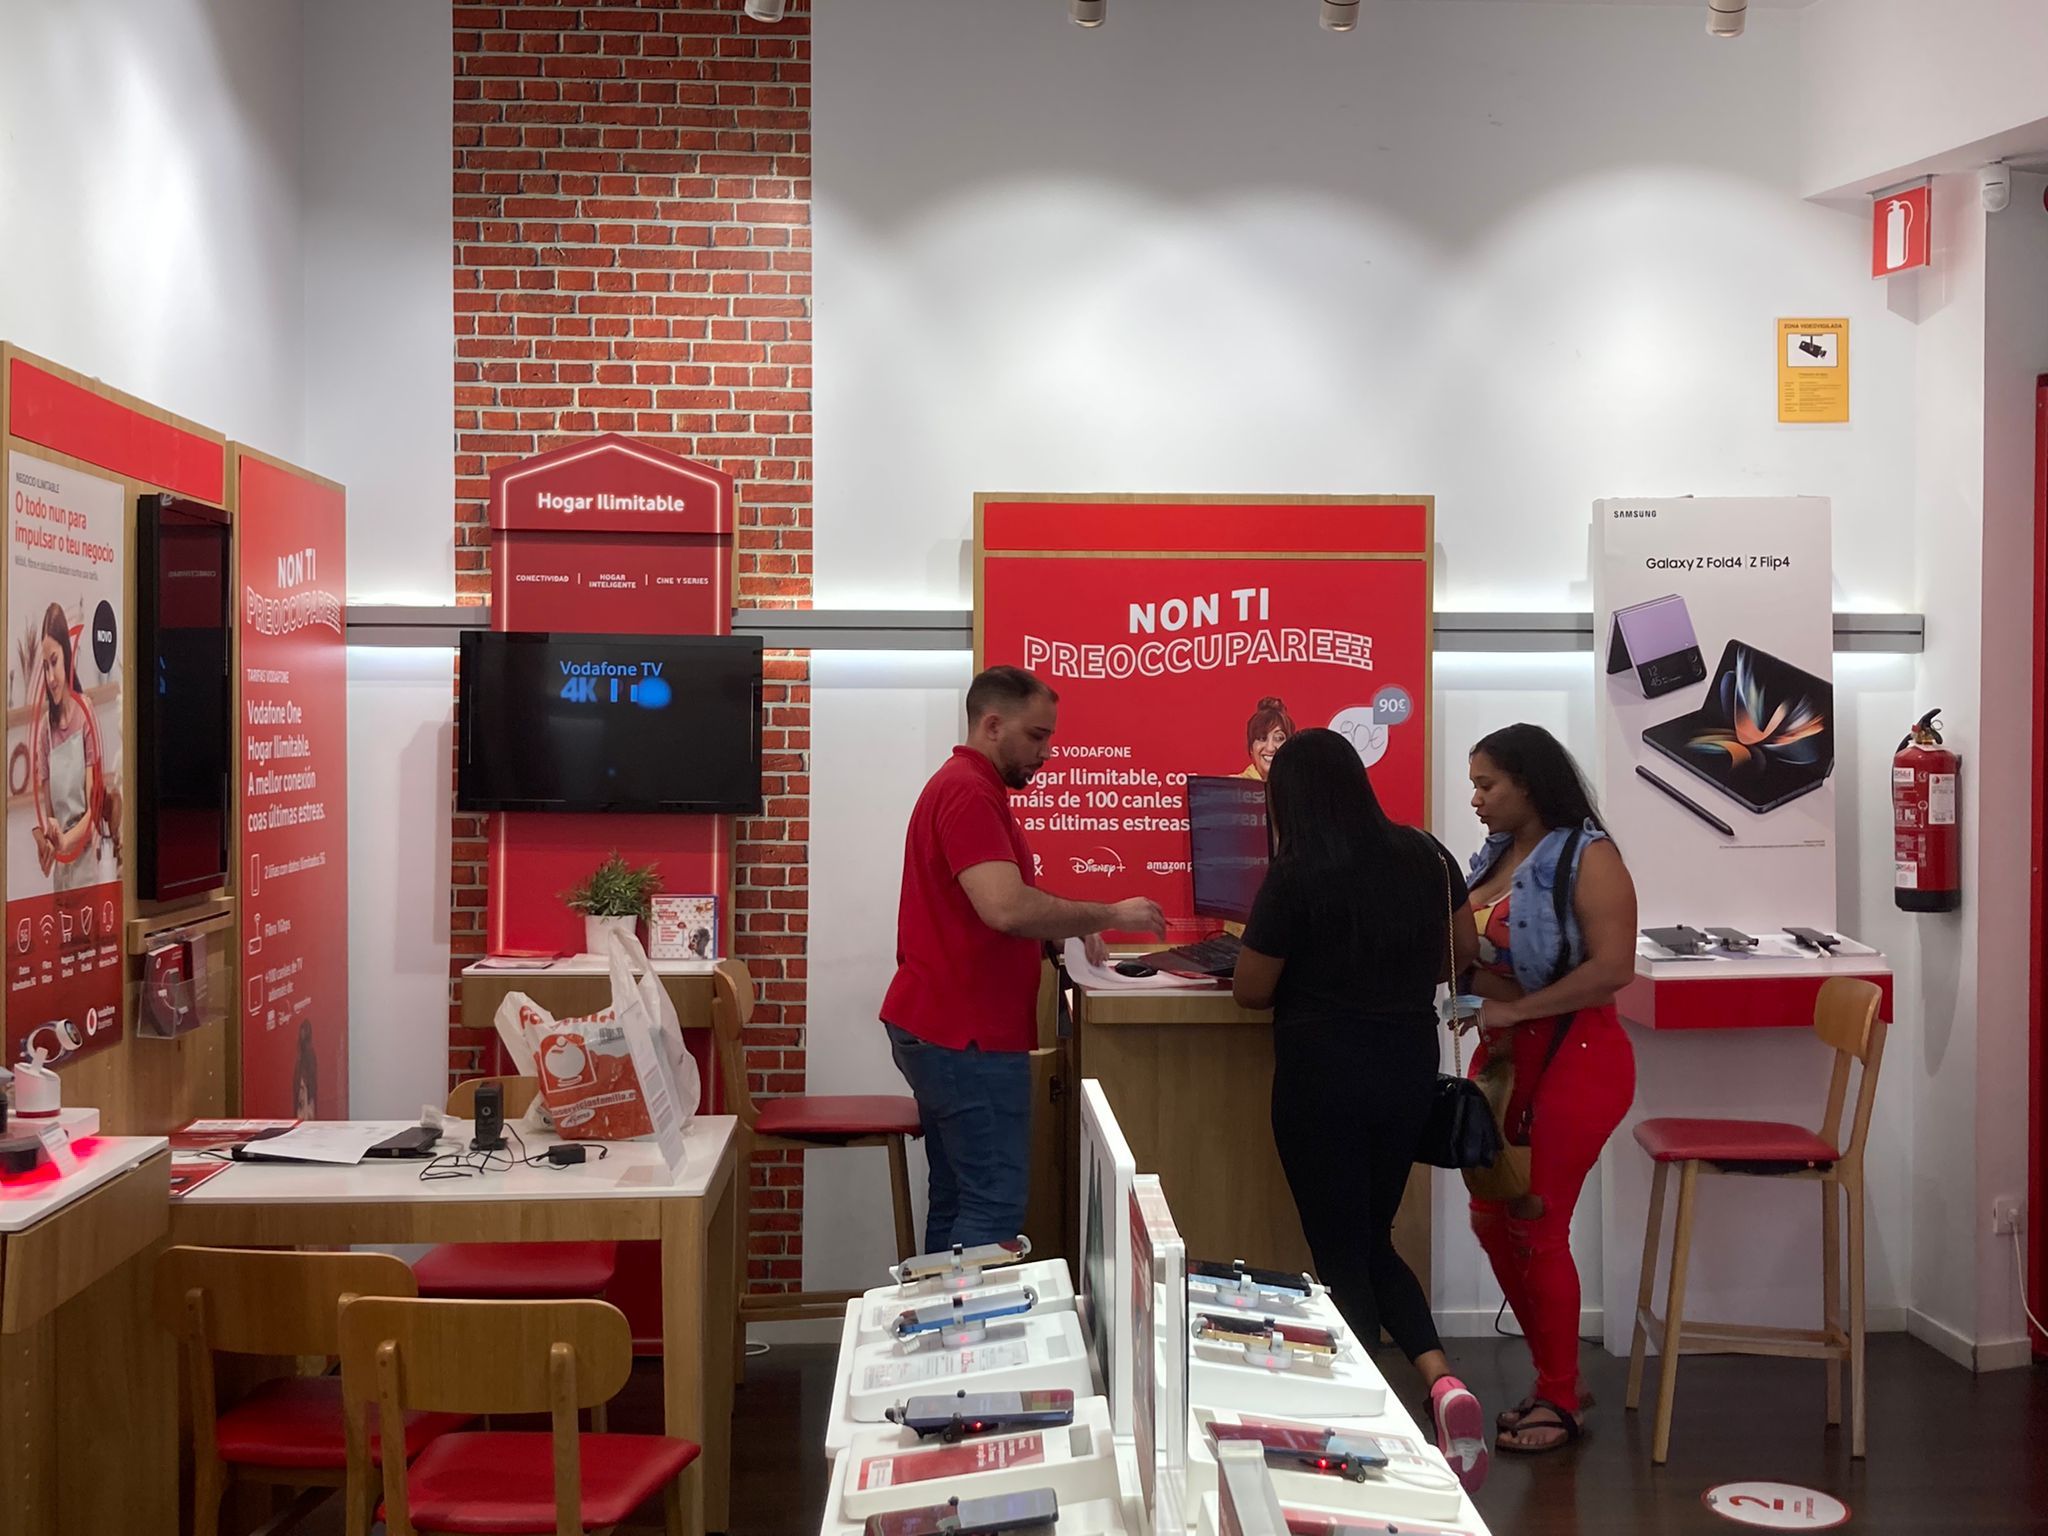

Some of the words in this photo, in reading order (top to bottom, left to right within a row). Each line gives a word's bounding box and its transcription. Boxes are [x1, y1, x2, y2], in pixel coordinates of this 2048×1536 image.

[16, 491, 24, 513] O
[25, 496, 47, 519] todo
[49, 504, 67, 524] nun
[68, 510, 87, 531] para
[537, 492, 594, 513] Hogar
[597, 494, 685, 513] Ilimitable
[1613, 510, 1657, 518] SAMSUNG
[15, 521, 56, 550] impulsar
[58, 536, 65, 551] o
[66, 537, 81, 556] teu
[81, 543, 114, 565] negocio
[278, 550, 304, 589] NON
[305, 548, 316, 581] TI
[1646, 557, 1694, 571] Galaxy
[1696, 557, 1704, 569] Z
[1706, 556, 1742, 569] Fold4
[1750, 557, 1757, 568] Z
[1760, 555, 1791, 571] Flip4
[515, 574, 569, 583] CONECTIVIDAD
[589, 581, 636, 589] INTELIGENTE
[600, 573, 626, 581] HOGAR
[656, 577, 674, 585] CINE
[676, 577, 682, 585] Y
[683, 577, 709, 585] SERIES
[1129, 593, 1219, 634] NON
[1231, 587, 1269, 622] TI
[560, 660, 638, 676] Vodafone
[641, 662, 663, 676] TV
[560, 676, 598, 703] 4K
[247, 700, 285, 725] Vodafone
[286, 700, 302, 724] One
[1379, 698, 1406, 713] 90€
[247, 735, 273, 766] Hogar
[274, 734, 311, 760] Ilimitable.
[1062, 746, 1132, 758] VODAFONE
[248, 771, 255, 797] A
[256, 770, 283, 796] mellor
[284, 765, 316, 792] conexión
[1026, 771, 1066, 789] ogar
[1070, 768, 1162, 788] Ilimitable,
[1166, 772, 1198, 786] co
[1010, 791, 1054, 808] máis
[1058, 791, 1081, 808] de
[1086, 791, 1119, 808] 100
[1122, 791, 1183, 808] canles
[248, 811, 267, 833] coas
[268, 803, 298, 830] últimas
[1024, 817, 1046, 831] as
[1050, 812, 1119, 831] últimas
[1123, 815, 1191, 832] estreas
[1069, 851, 1126, 877] Disney+
[1147, 861, 1186, 872] amazon
